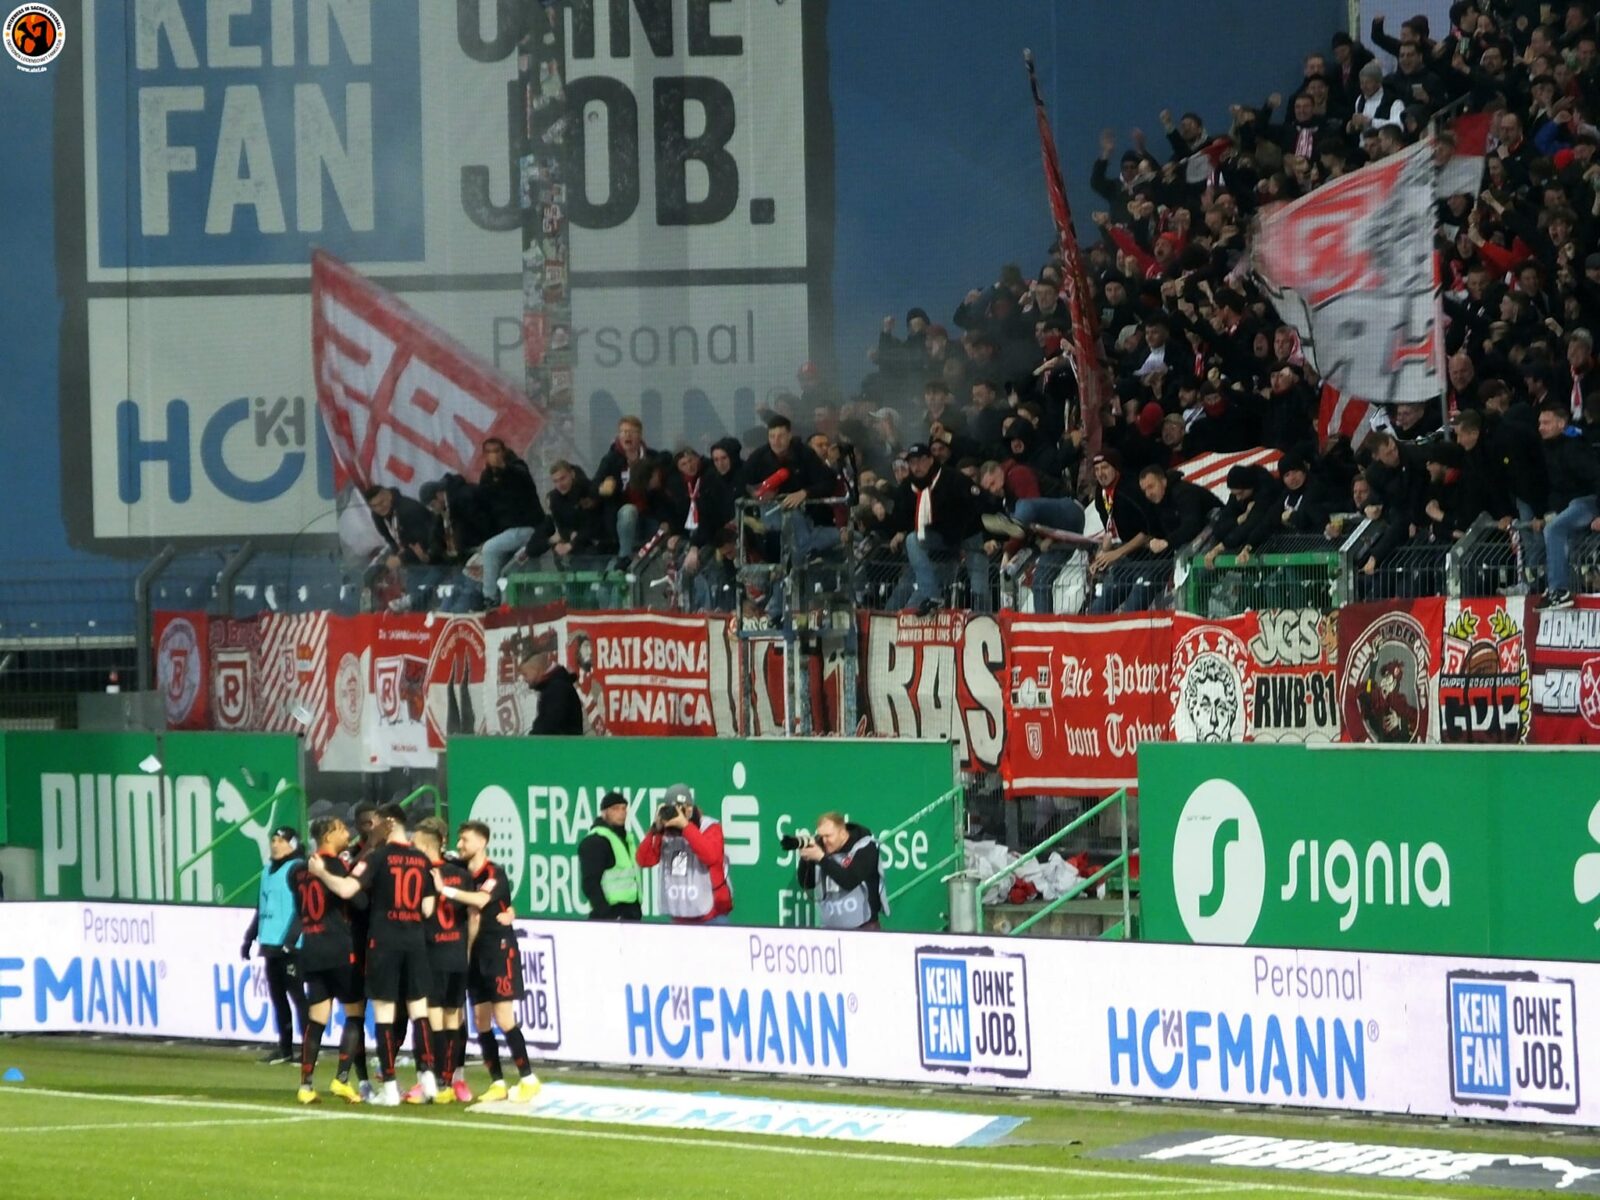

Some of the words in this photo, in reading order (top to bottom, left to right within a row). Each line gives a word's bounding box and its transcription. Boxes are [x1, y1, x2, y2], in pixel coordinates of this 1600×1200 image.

[138, 82, 375, 236] FAN
[460, 75, 776, 231] JOB.
[492, 309, 755, 369] Prsonal
[1251, 609, 1321, 666] JGS
[1536, 610, 1600, 650] DONAU
[597, 637, 708, 673] RATISBONA
[1060, 655, 1093, 698] Die
[1102, 653, 1168, 706] Power
[609, 689, 712, 727] FANATICA
[1065, 719, 1101, 758] vom
[40, 773, 213, 902] PUMA
[389, 866, 423, 910] 10
[1281, 838, 1451, 931] signia
[83, 908, 155, 944] Personal
[750, 935, 843, 975] Personal
[495, 976, 513, 996] 26
[925, 967, 962, 1005] KEIN
[972, 970, 1016, 1007] OHNE
[1254, 955, 1363, 1001] Personal
[928, 1007, 965, 1053] FAN
[975, 1012, 1023, 1057] JOB.
[1458, 992, 1501, 1036] KEIN
[1512, 995, 1563, 1037] OHNE
[1461, 1036, 1504, 1087] FAN
[1516, 1042, 1571, 1091] JOB.
